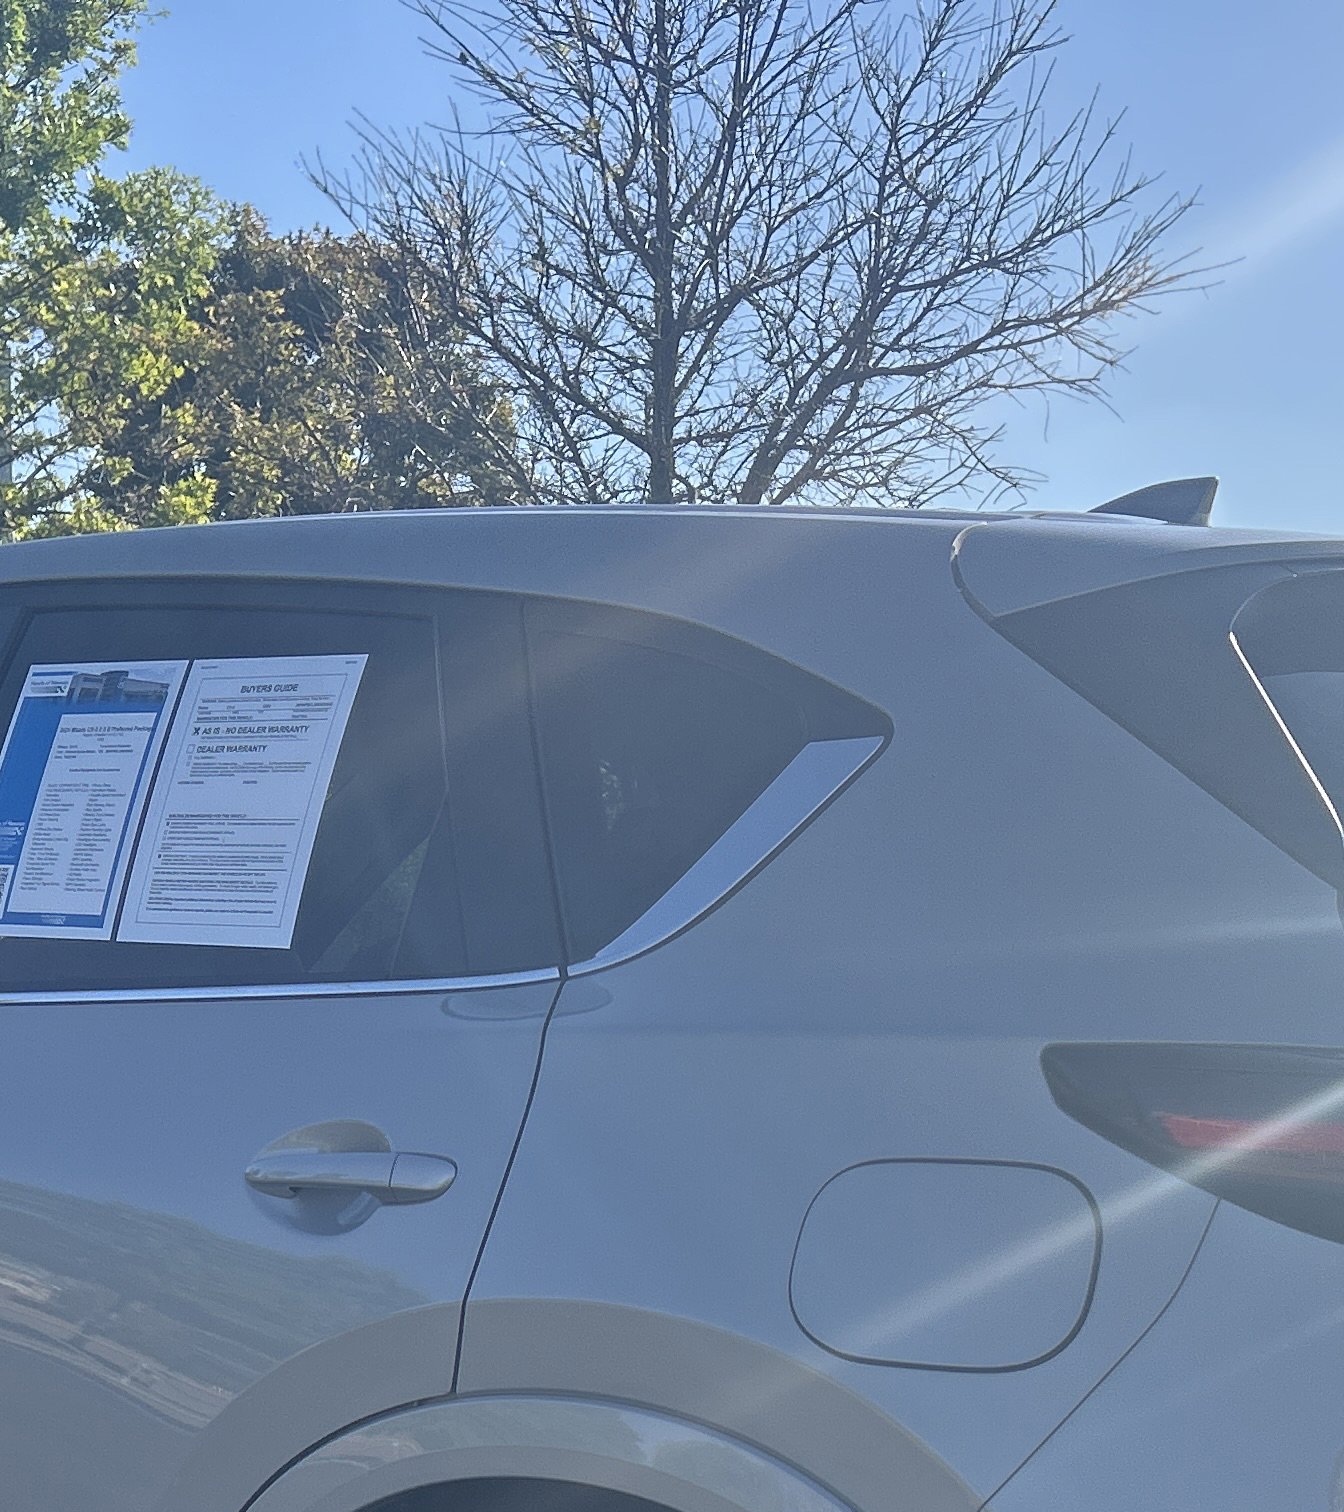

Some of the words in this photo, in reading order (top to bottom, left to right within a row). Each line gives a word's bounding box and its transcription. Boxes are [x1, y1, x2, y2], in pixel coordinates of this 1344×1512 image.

[240, 684, 272, 693] BUYERS
[274, 684, 299, 692] GUIDE
[202, 727, 212, 735] AS
[213, 727, 220, 735] IS
[225, 727, 236, 735] NO
[237, 726, 268, 735] DEALER
[268, 725, 310, 734] WARRANTY
[196, 745, 226, 753] DEALER
[226, 744, 268, 753] WARRANTY
